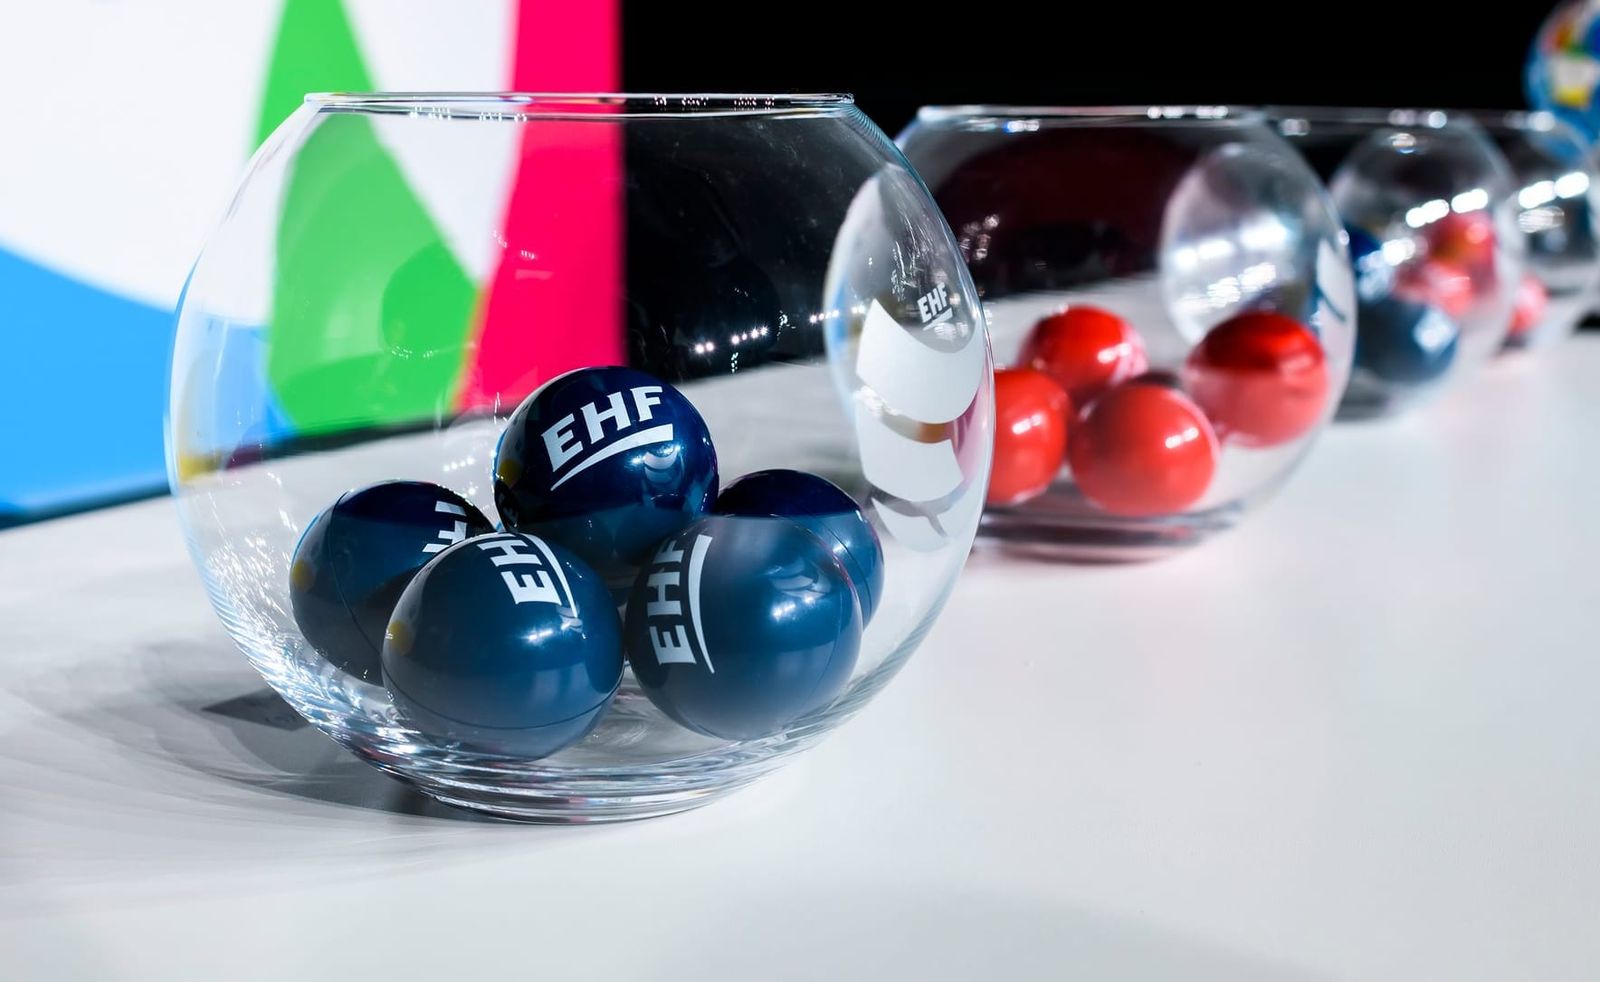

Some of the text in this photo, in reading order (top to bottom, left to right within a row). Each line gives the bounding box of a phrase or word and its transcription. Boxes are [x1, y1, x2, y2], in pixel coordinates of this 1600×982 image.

[918, 283, 947, 323] EHF
[541, 386, 663, 471] EHF
[477, 532, 562, 606] EH
[646, 538, 697, 666] EHF
